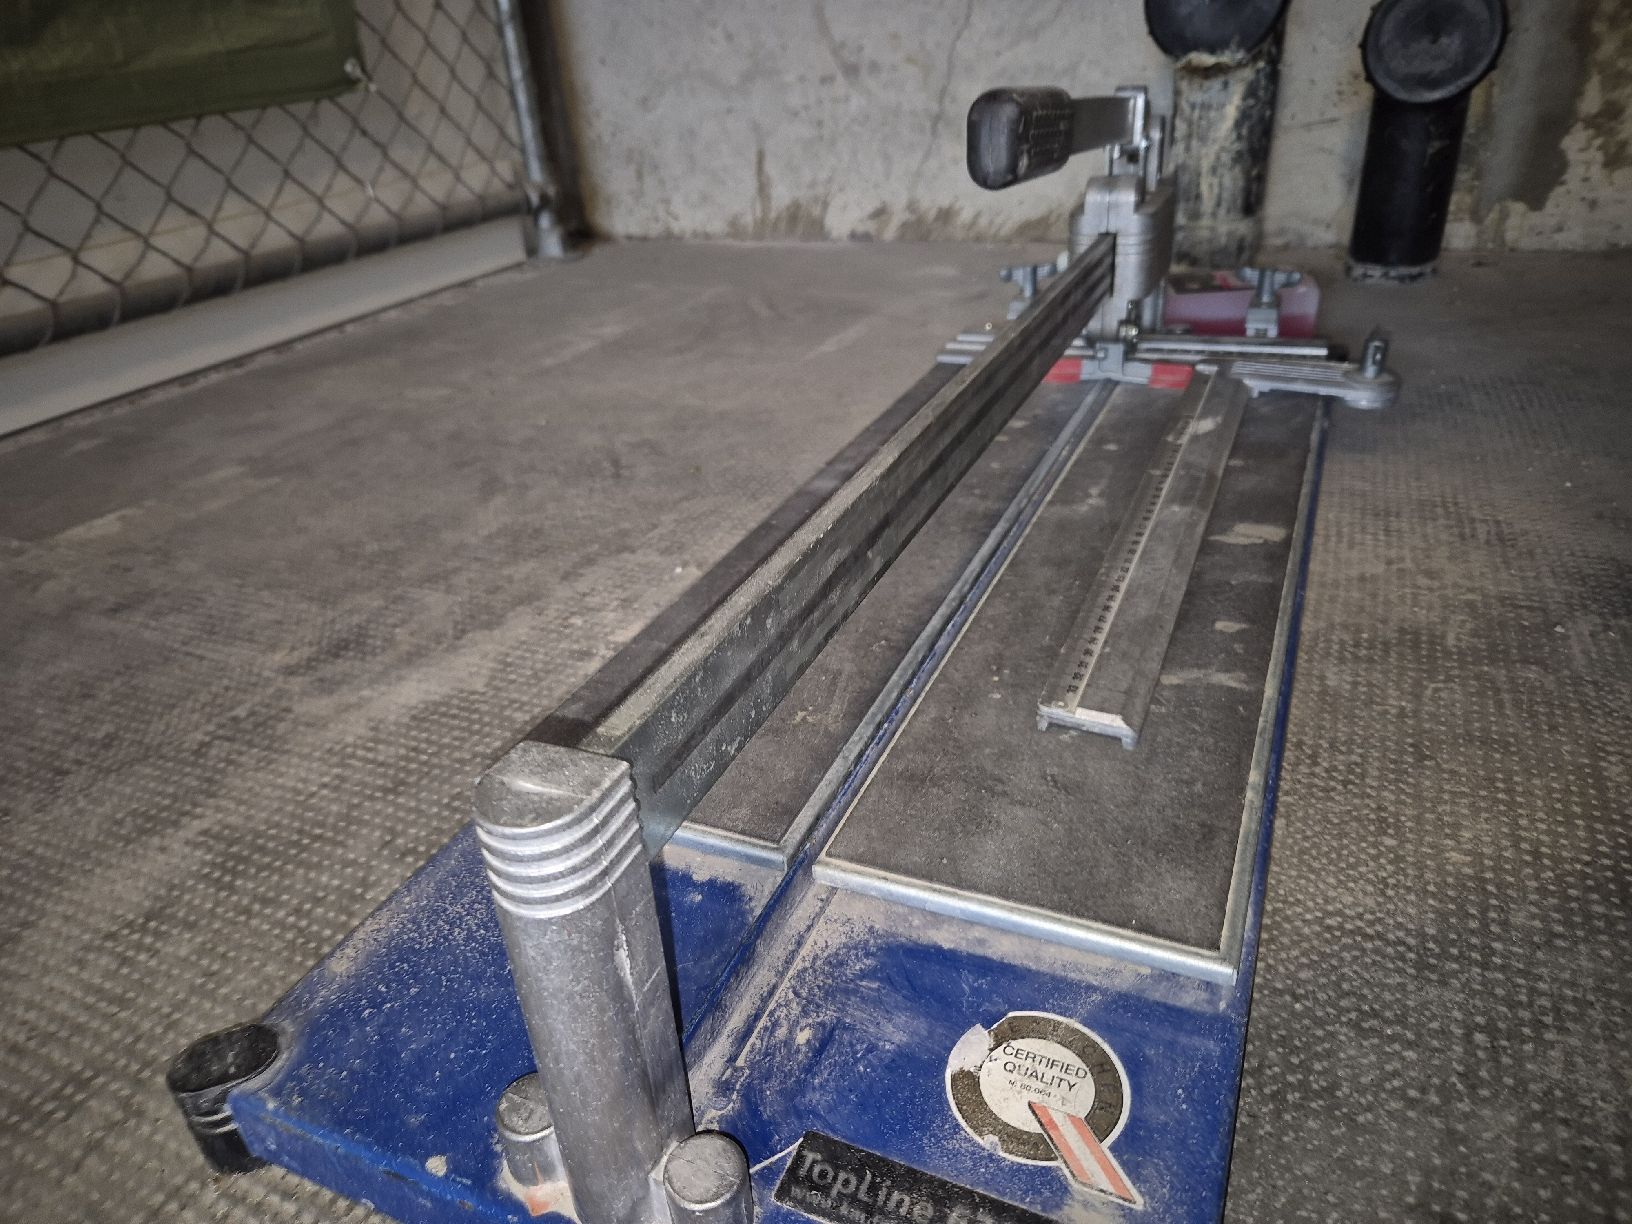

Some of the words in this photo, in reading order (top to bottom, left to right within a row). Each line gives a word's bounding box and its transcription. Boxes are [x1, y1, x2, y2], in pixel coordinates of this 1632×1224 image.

[1002, 1043, 1088, 1080] CERTIFIED
[1003, 1060, 1078, 1092] QUALITY
[799, 1150, 934, 1224] TopLine
